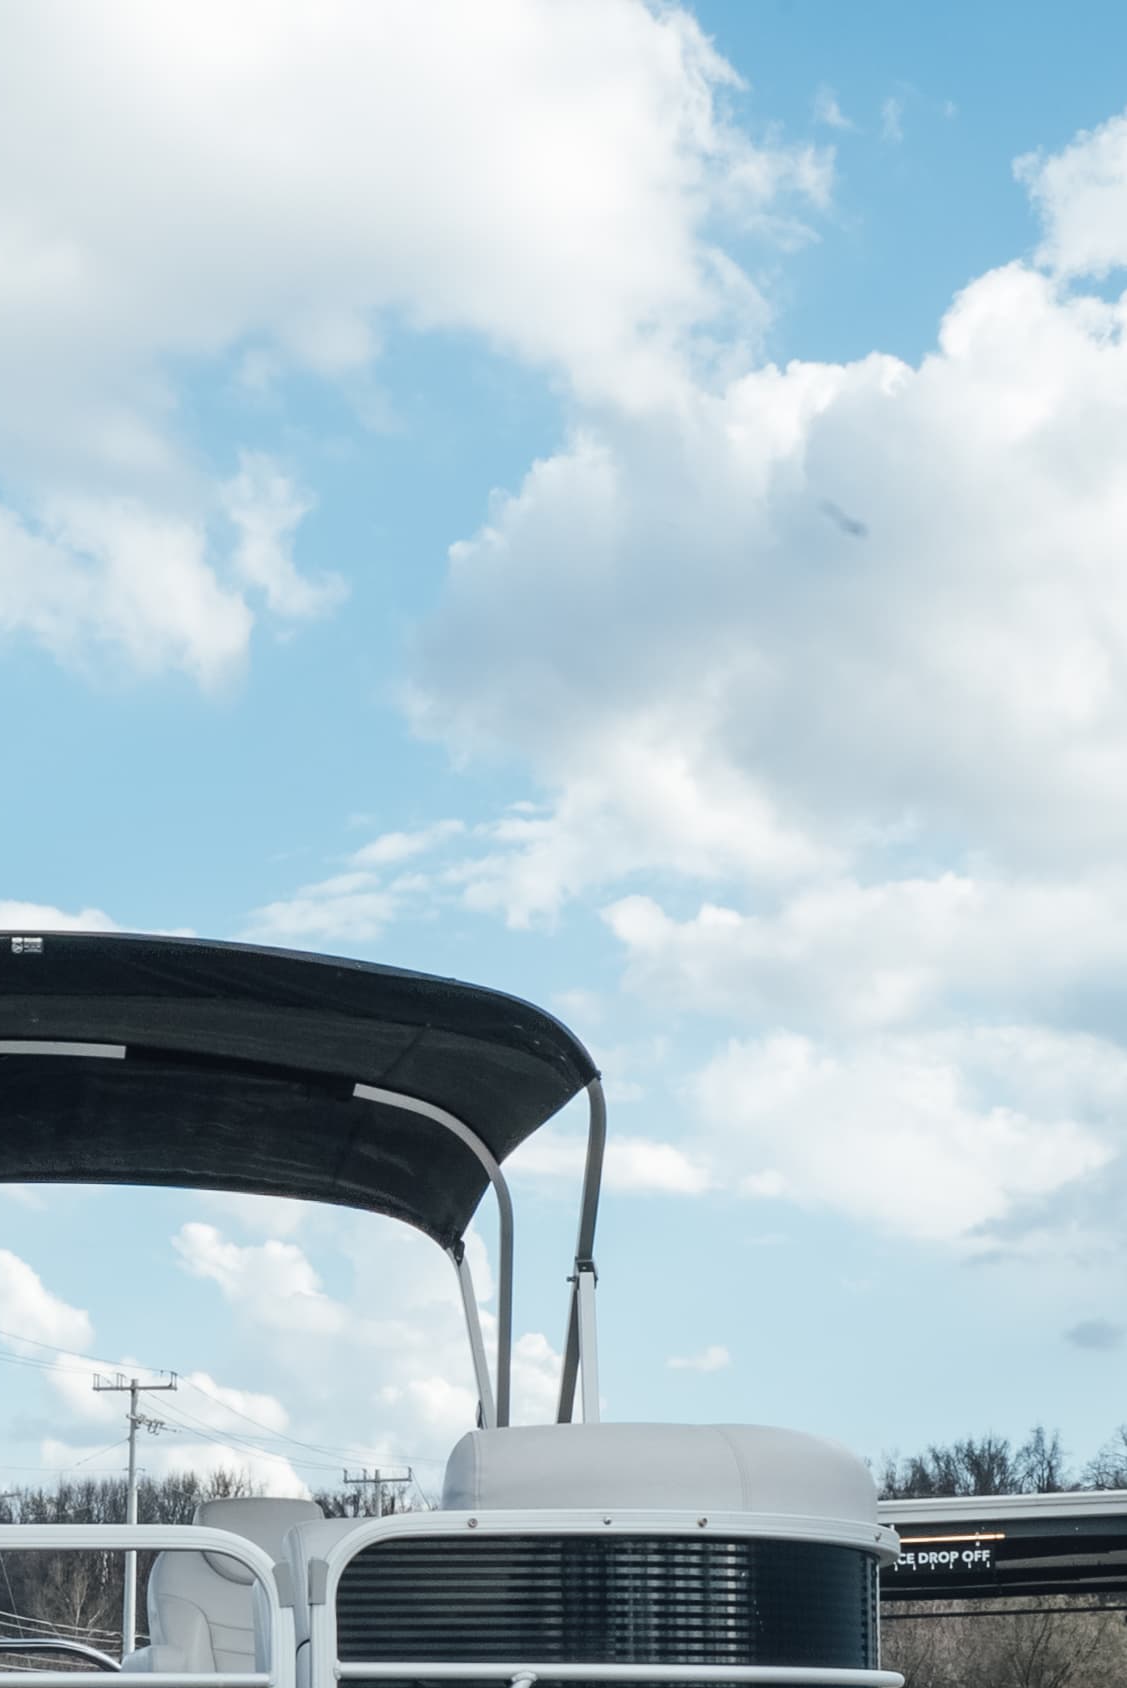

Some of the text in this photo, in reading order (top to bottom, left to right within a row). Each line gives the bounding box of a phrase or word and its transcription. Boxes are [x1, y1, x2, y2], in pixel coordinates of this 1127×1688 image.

[897, 1549, 991, 1565] CE DROP OFF
